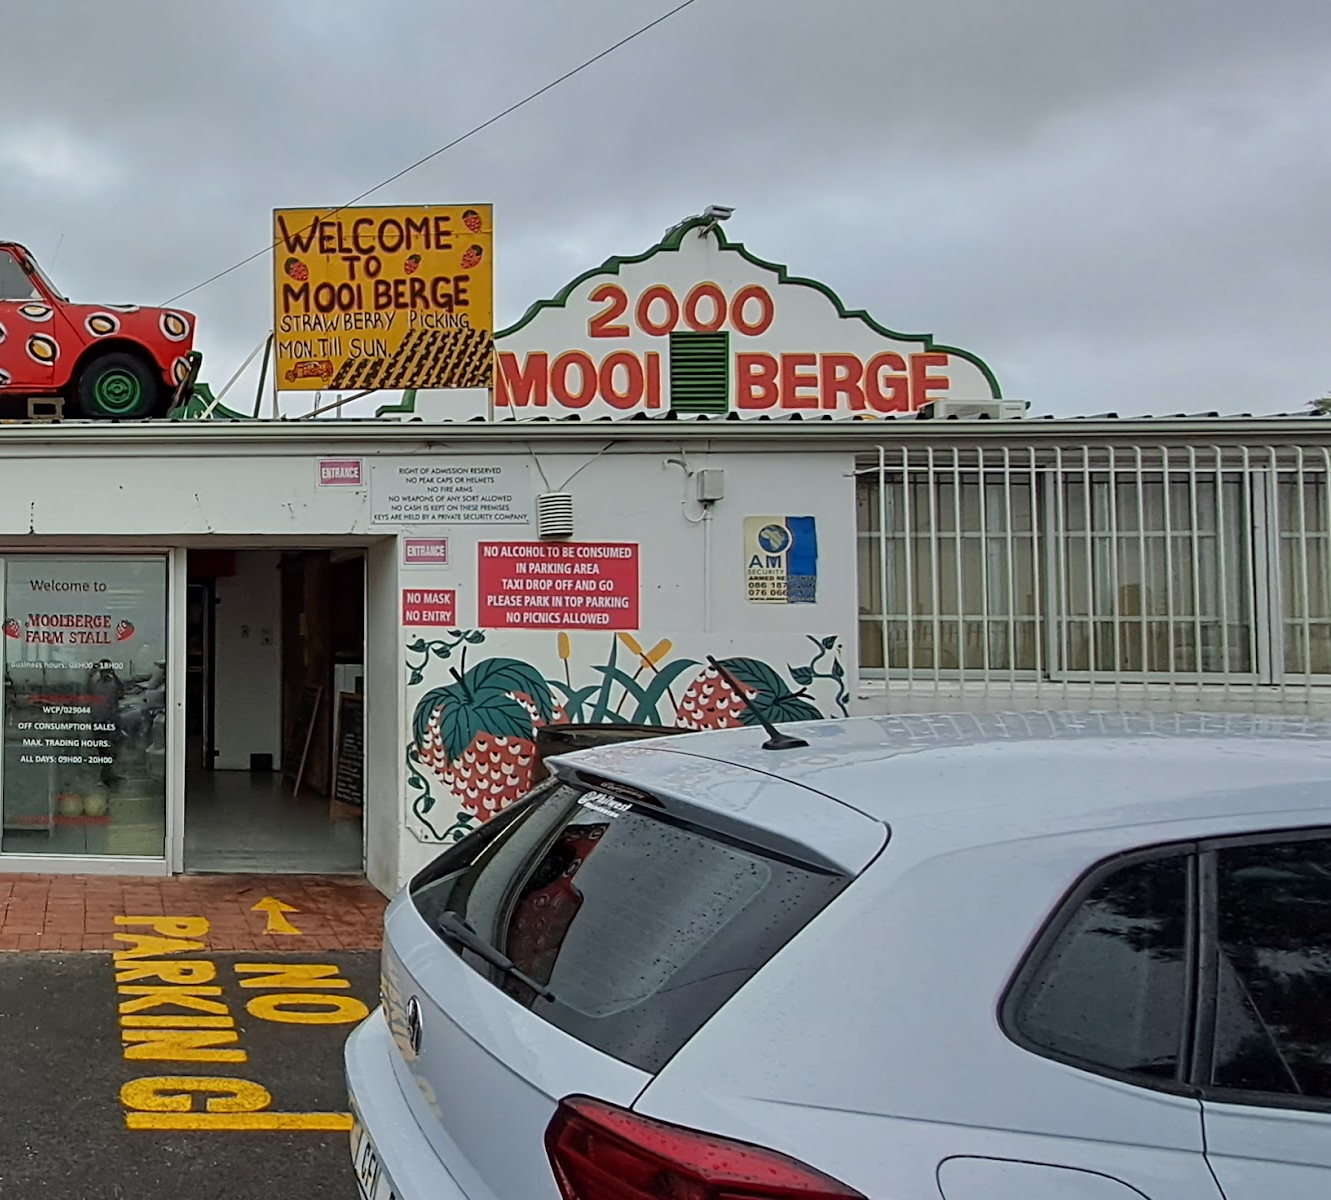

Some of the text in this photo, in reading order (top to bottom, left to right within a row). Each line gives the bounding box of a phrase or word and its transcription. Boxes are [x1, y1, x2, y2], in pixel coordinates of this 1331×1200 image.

[277, 215, 452, 255] WELCOME
[341, 255, 382, 281] TO
[282, 275, 470, 314] MOOI BERGE
[587, 281, 775, 338] 2000
[350, 338, 392, 359] SUN.
[494, 350, 950, 412] MOOI BERGE
[321, 466, 360, 479] ENTRANCE
[399, 467, 502, 475] RIGHT OF ADMISSION RESERVED
[374, 513, 527, 521] KEYS ARE HELD BY A PRIVATE SECURITY COMPANY
[406, 545, 445, 557] ENTRANCE
[484, 546, 632, 559] NO ALCOHOL TO BE CONSUMED
[748, 555, 782, 568] AM
[516, 563, 600, 575] IN PARKING AREA
[30, 580, 107, 592] Welcome to
[501, 579, 614, 592] TAXI DROP OFF AND GO
[406, 592, 451, 605] NO MASK
[487, 595, 629, 608] PLEASE PARK IN TOP PARKING
[25, 614, 112, 628] MOOIBERGE
[405, 610, 452, 622] NO ENTRY
[506, 612, 610, 625] NO PICNICS ALLOWED
[25, 631, 111, 644] FARM STALL
[18, 722, 116, 731] OFF CONSUMPTION SALES
[45, 739, 79, 748] TRADING
[20, 755, 34, 763] ALL
[88, 756, 113, 764] 20H00
[233, 963, 370, 1025] NO
[113, 915, 272, 1113] PARKING
